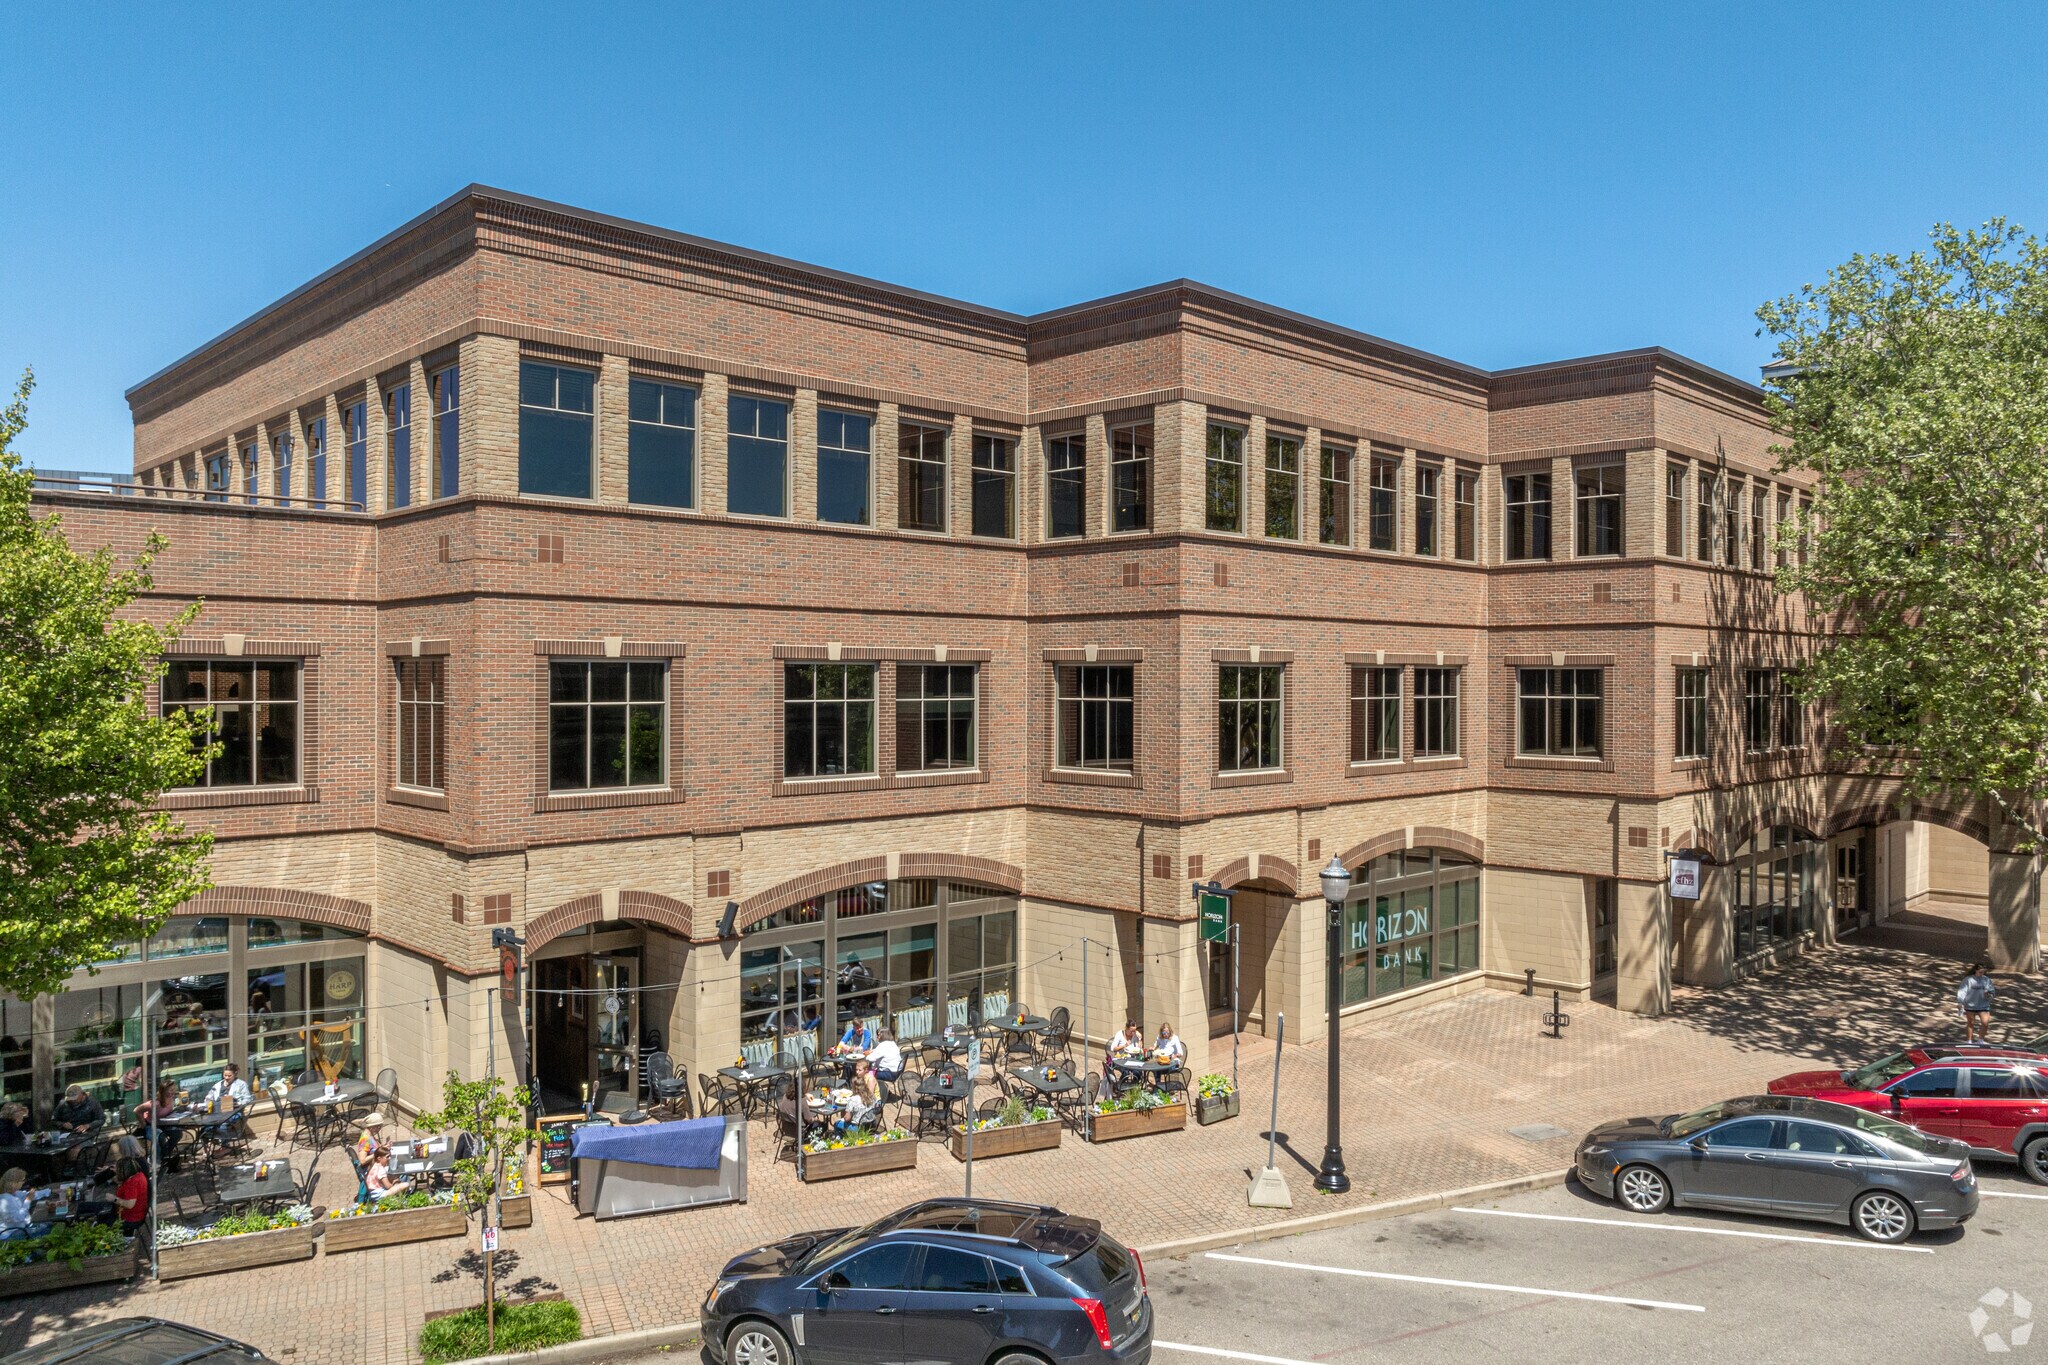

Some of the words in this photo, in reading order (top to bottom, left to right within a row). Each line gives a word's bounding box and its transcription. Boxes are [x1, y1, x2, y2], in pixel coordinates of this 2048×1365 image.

[1675, 876, 1694, 886] cfhz
[1204, 912, 1223, 920] HORIZON
[1383, 946, 1422, 970] BANK
[329, 981, 352, 990] HARP
